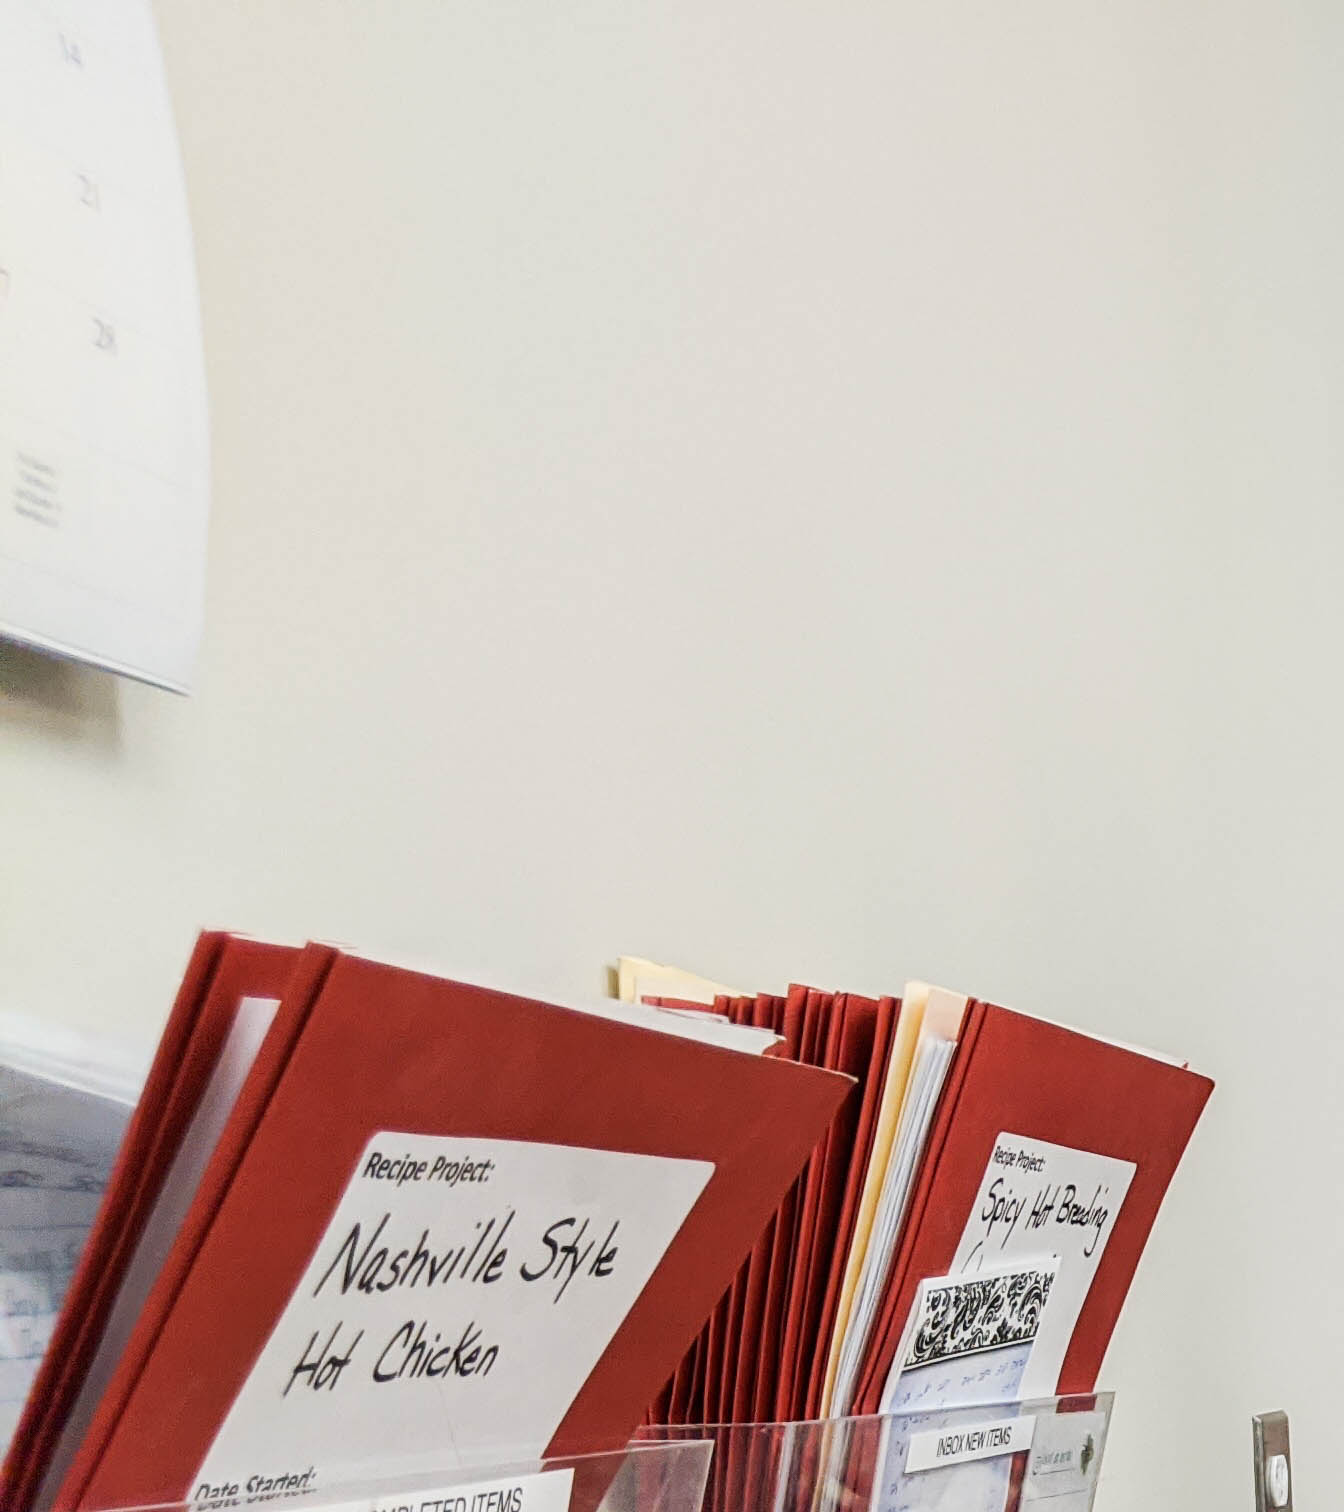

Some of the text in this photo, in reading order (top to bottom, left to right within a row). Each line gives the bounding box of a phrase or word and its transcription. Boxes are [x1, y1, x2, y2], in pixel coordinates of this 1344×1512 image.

[362, 1151, 496, 1190] Recipe Project:
[992, 1145, 1047, 1175] Recipe Project:
[981, 1176, 1028, 1250] Spicy
[1024, 1183, 1062, 1231] Hot
[312, 1209, 620, 1305] Nashville Style
[283, 1319, 500, 1399] Hot Chicken
[936, 1426, 1013, 1458] INBOX NEW ITEMS
